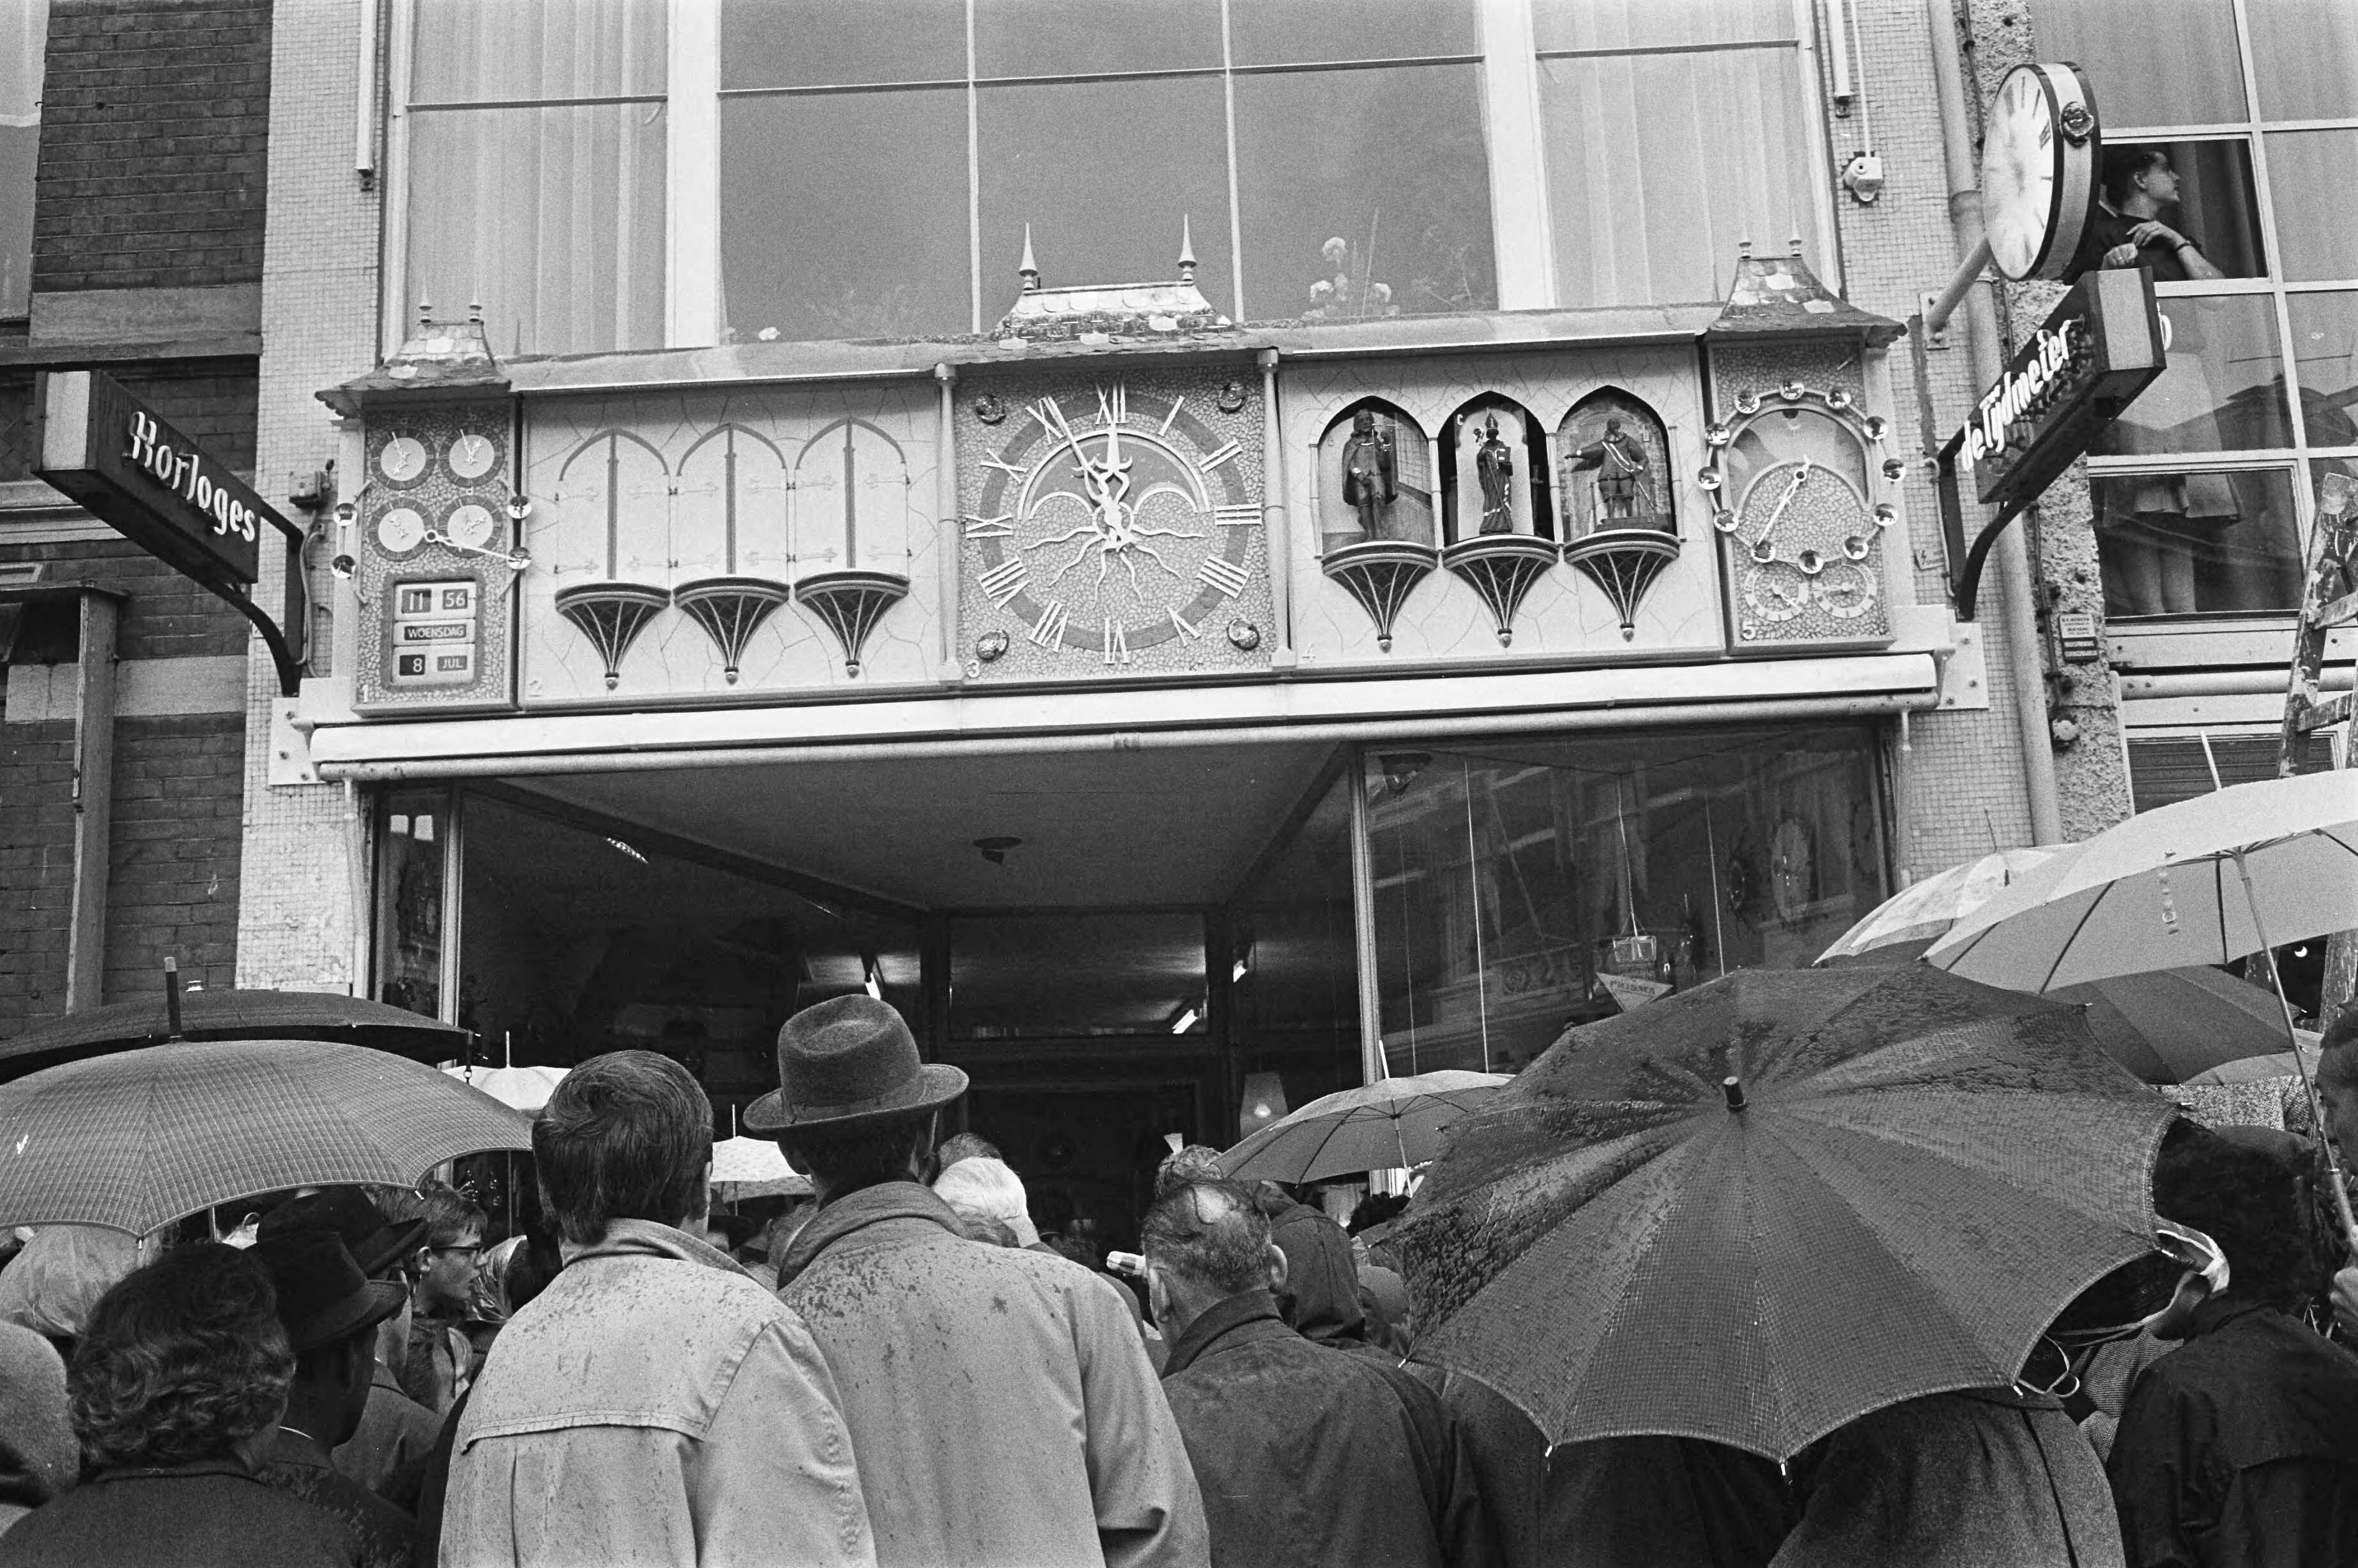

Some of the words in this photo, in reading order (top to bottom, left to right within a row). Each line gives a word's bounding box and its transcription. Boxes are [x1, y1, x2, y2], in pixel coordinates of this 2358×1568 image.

[980, 448, 1029, 484] X
[1198, 438, 1243, 474] II
[130, 411, 256, 542] Horloges
[1214, 503, 1262, 526] III
[410, 592, 423, 611] 11
[445, 592, 465, 607] 56
[408, 627, 464, 638] WOENSDAG
[1163, 604, 1202, 648] V
[1742, 621, 1756, 639] 5
[1103, 617, 1130, 664] VI
[413, 658, 422, 673] 8
[443, 658, 463, 668] JUL
[967, 658, 981, 678] 3
[362, 683, 369, 703] 1
[1609, 980, 1656, 995] PRISMA
